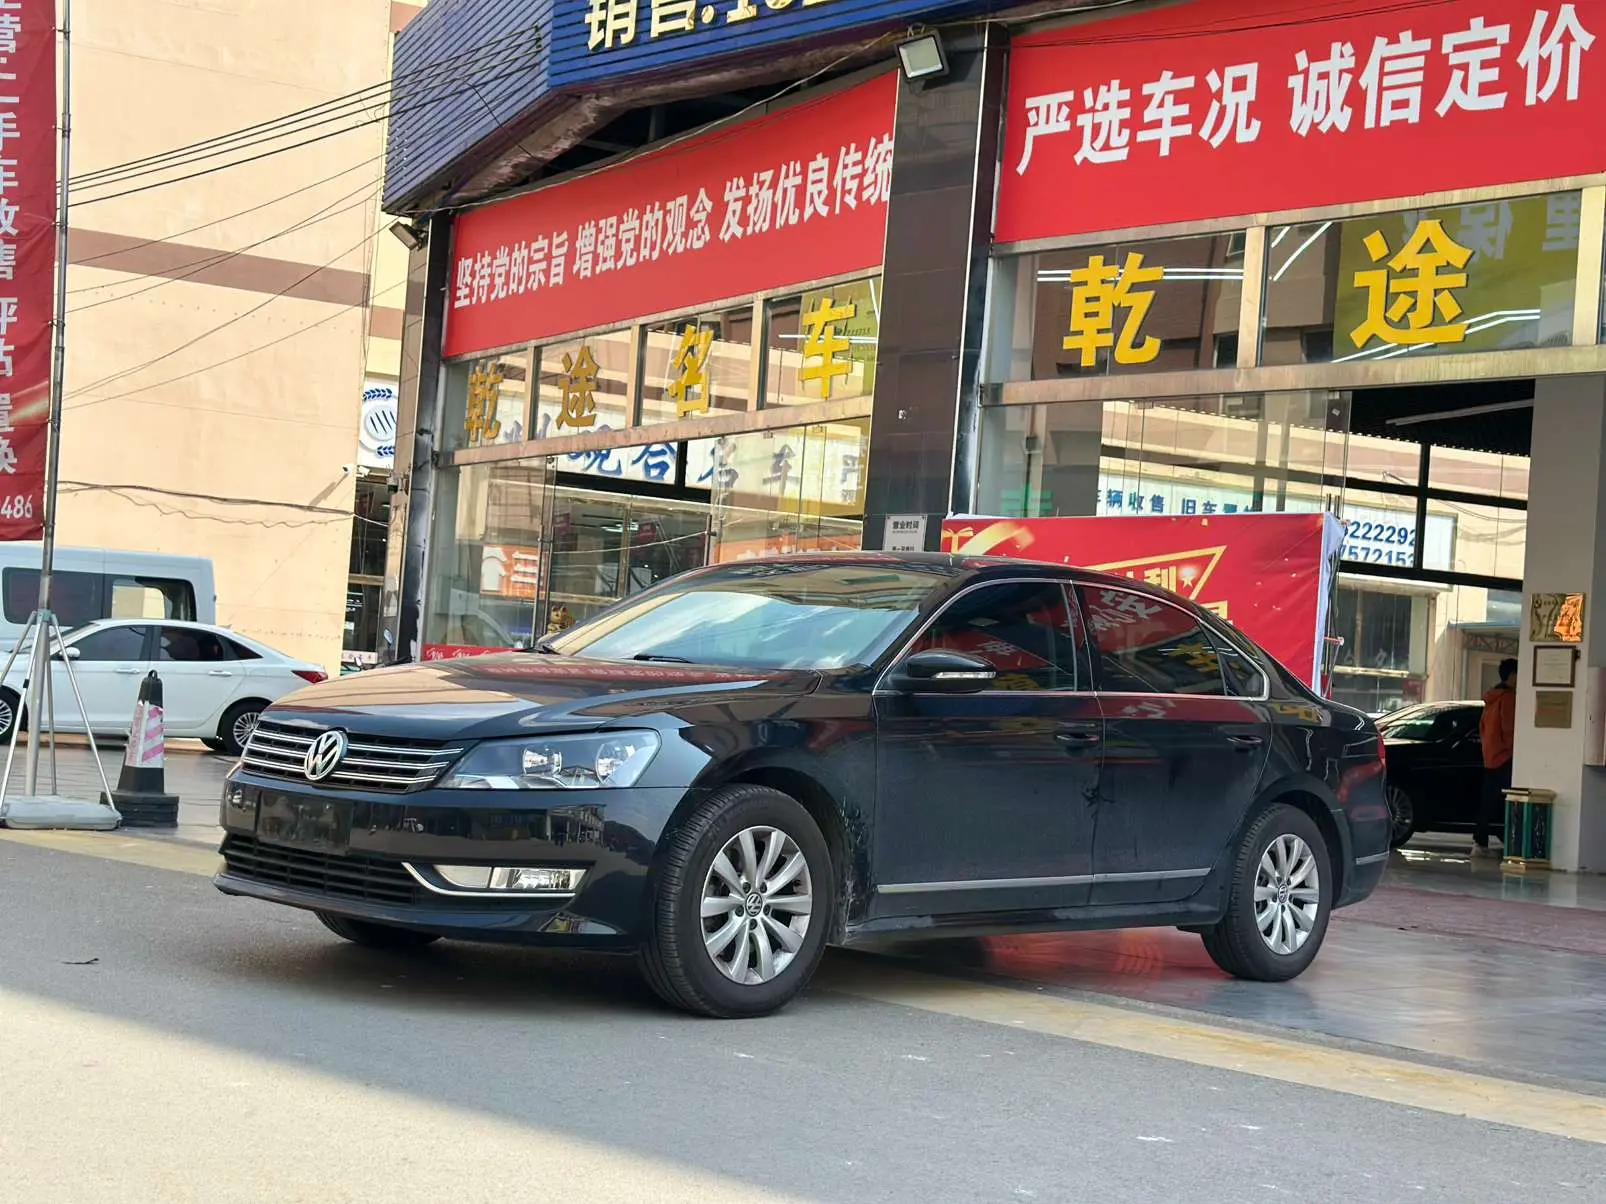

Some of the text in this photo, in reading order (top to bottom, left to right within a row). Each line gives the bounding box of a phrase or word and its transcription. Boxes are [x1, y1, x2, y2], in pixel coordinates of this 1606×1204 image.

[1016, 3, 1596, 176] 严选车况 诚信定价
[454, 132, 896, 310] 坚持党的宗旨 增强党的观念 发扬优良传统
[1063, 218, 1475, 368] 乾途
[463, 296, 858, 443] 乾途名车
